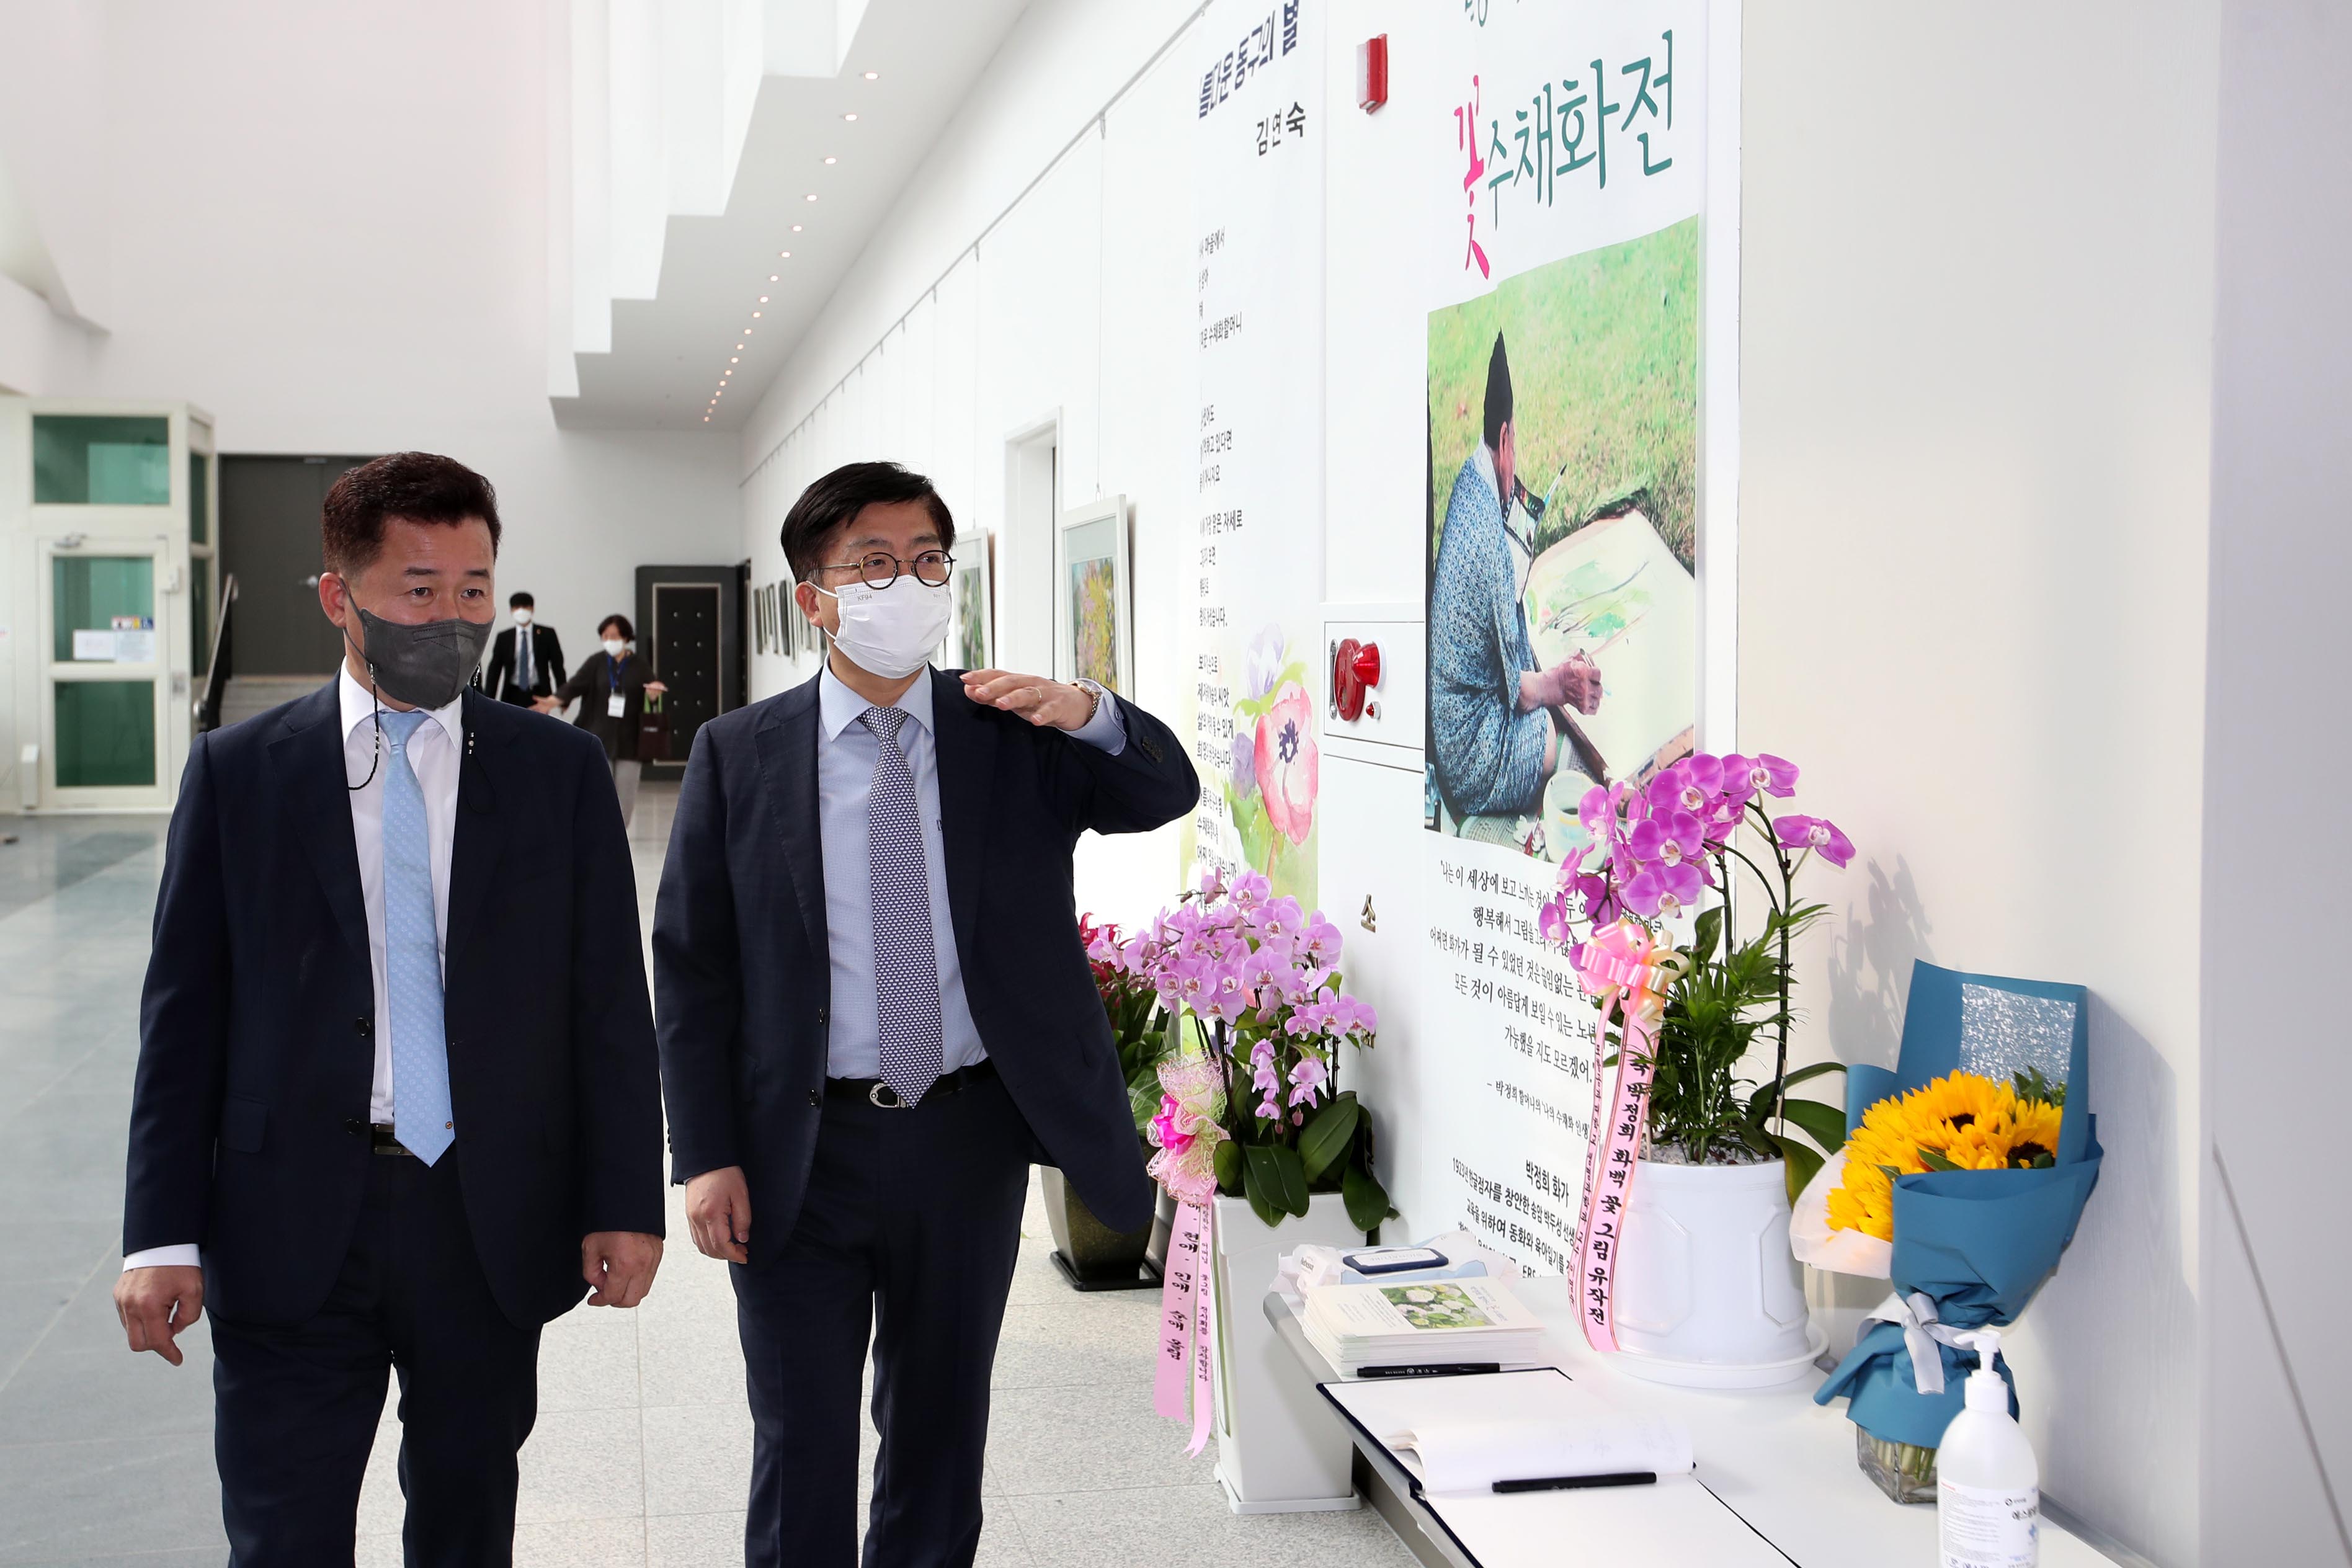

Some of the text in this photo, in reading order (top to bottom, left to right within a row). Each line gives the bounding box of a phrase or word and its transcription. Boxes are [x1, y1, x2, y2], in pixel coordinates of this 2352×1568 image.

[1234, 10, 1275, 91] 동구의
[1257, 101, 1306, 156] 김연숙
[1216, 429, 1232, 453] 있다면
[1223, 509, 1242, 532] 자세로
[857, 594, 873, 602] KF94
[1222, 718, 1234, 740] 있게
[1456, 866, 1464, 887] 이
[1467, 869, 1499, 894] 세상에
[1501, 877, 1517, 898] 보고
[1518, 883, 1534, 908] 느끼는
[1473, 906, 1511, 937] 행복해서
[1513, 919, 1534, 947] 그림을
[1430, 926, 1448, 951] 어쩌면
[1449, 935, 1469, 960] 화가가
[1472, 942, 1484, 964] 될
[1487, 945, 1499, 968] 수
[1501, 950, 1523, 978] 있었던
[1526, 959, 1540, 984] 것은
[1454, 972, 1468, 996] 모든
[1471, 978, 1494, 1004] 것이
[1497, 984, 1528, 1017] 아름답게
[1530, 1000, 1546, 1025] 보일
[1548, 1007, 1554, 1029] 수
[1555, 1011, 1574, 1038] 있는
[1504, 1025, 1533, 1057] 가능했을
[1536, 1040, 1551, 1063] 지도
[1495, 1080, 1518, 1103] 박정희
[1519, 1089, 1541, 1116] 할머니의
[1556, 1110, 1574, 1133] 수채화
[1618, 1082, 1645, 1142] 박정희
[1526, 1159, 1549, 1196] 박정희
[1552, 1175, 1569, 1208] 화가
[1609, 1148, 1634, 1189] 화백
[1469, 1169, 1502, 1203] 한글점자를
[1504, 1187, 1530, 1216] 창안한
[1530, 1201, 1543, 1224] 송암
[1544, 1208, 1562, 1237] 박두성
[1601, 1195, 1623, 1214] 꽃
[1466, 1198, 1480, 1224] 교육을
[1481, 1210, 1506, 1239] 위하여
[1509, 1223, 1533, 1252] 동화와
[1535, 1237, 1565, 1275] 육아일기를
[1593, 1223, 1615, 1261] 그림
[1587, 1267, 1609, 1326] 유작전
